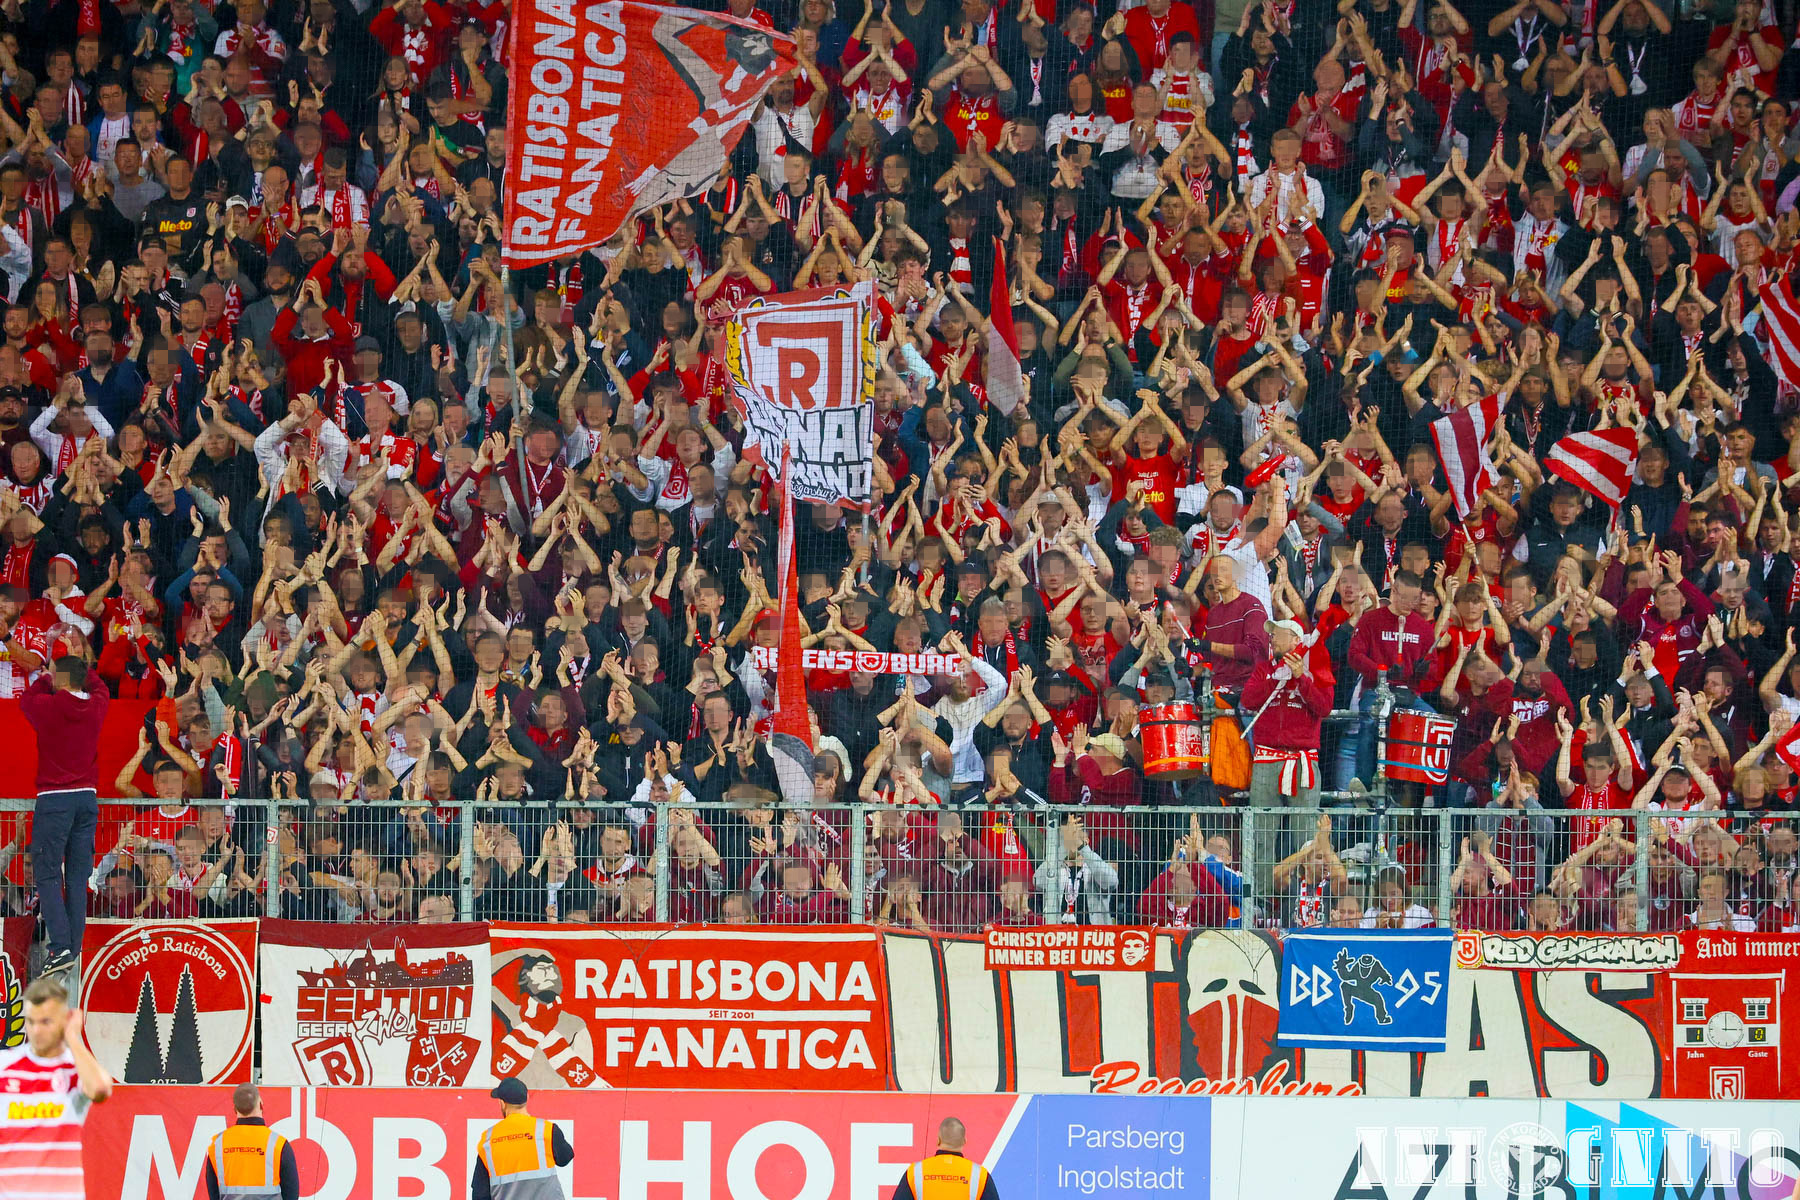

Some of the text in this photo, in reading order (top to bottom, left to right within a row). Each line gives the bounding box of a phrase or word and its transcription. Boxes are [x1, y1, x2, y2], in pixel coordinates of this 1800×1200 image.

[511, 0, 577, 246] RATISBONA
[555, 0, 627, 244] FANATICA
[1138, 490, 1165, 503] etto
[753, 645, 853, 670] REENS
[988, 928, 1116, 948] CHRISTOPH FÜR
[1482, 936, 1679, 966] RED GENERATION
[1696, 936, 1738, 959] Andi
[106, 936, 228, 981] Gruppo Ratisbona
[988, 948, 1116, 966] IMMER BEI UNS
[574, 959, 877, 1002] RATISBONA
[1290, 963, 1443, 1009] BB 95
[427, 1019, 468, 1036] 2019
[709, 1010, 754, 1020] SEIT 2001
[883, 935, 1657, 1096] ULTAS
[605, 1027, 877, 1070] FANATICA
[1686, 1050, 1705, 1060] Jahn
[121, 1087, 913, 1200] MÖBHOF
[1067, 1124, 1185, 1155] Parsberg
[1057, 1163, 1185, 1191] Ingolstadt
